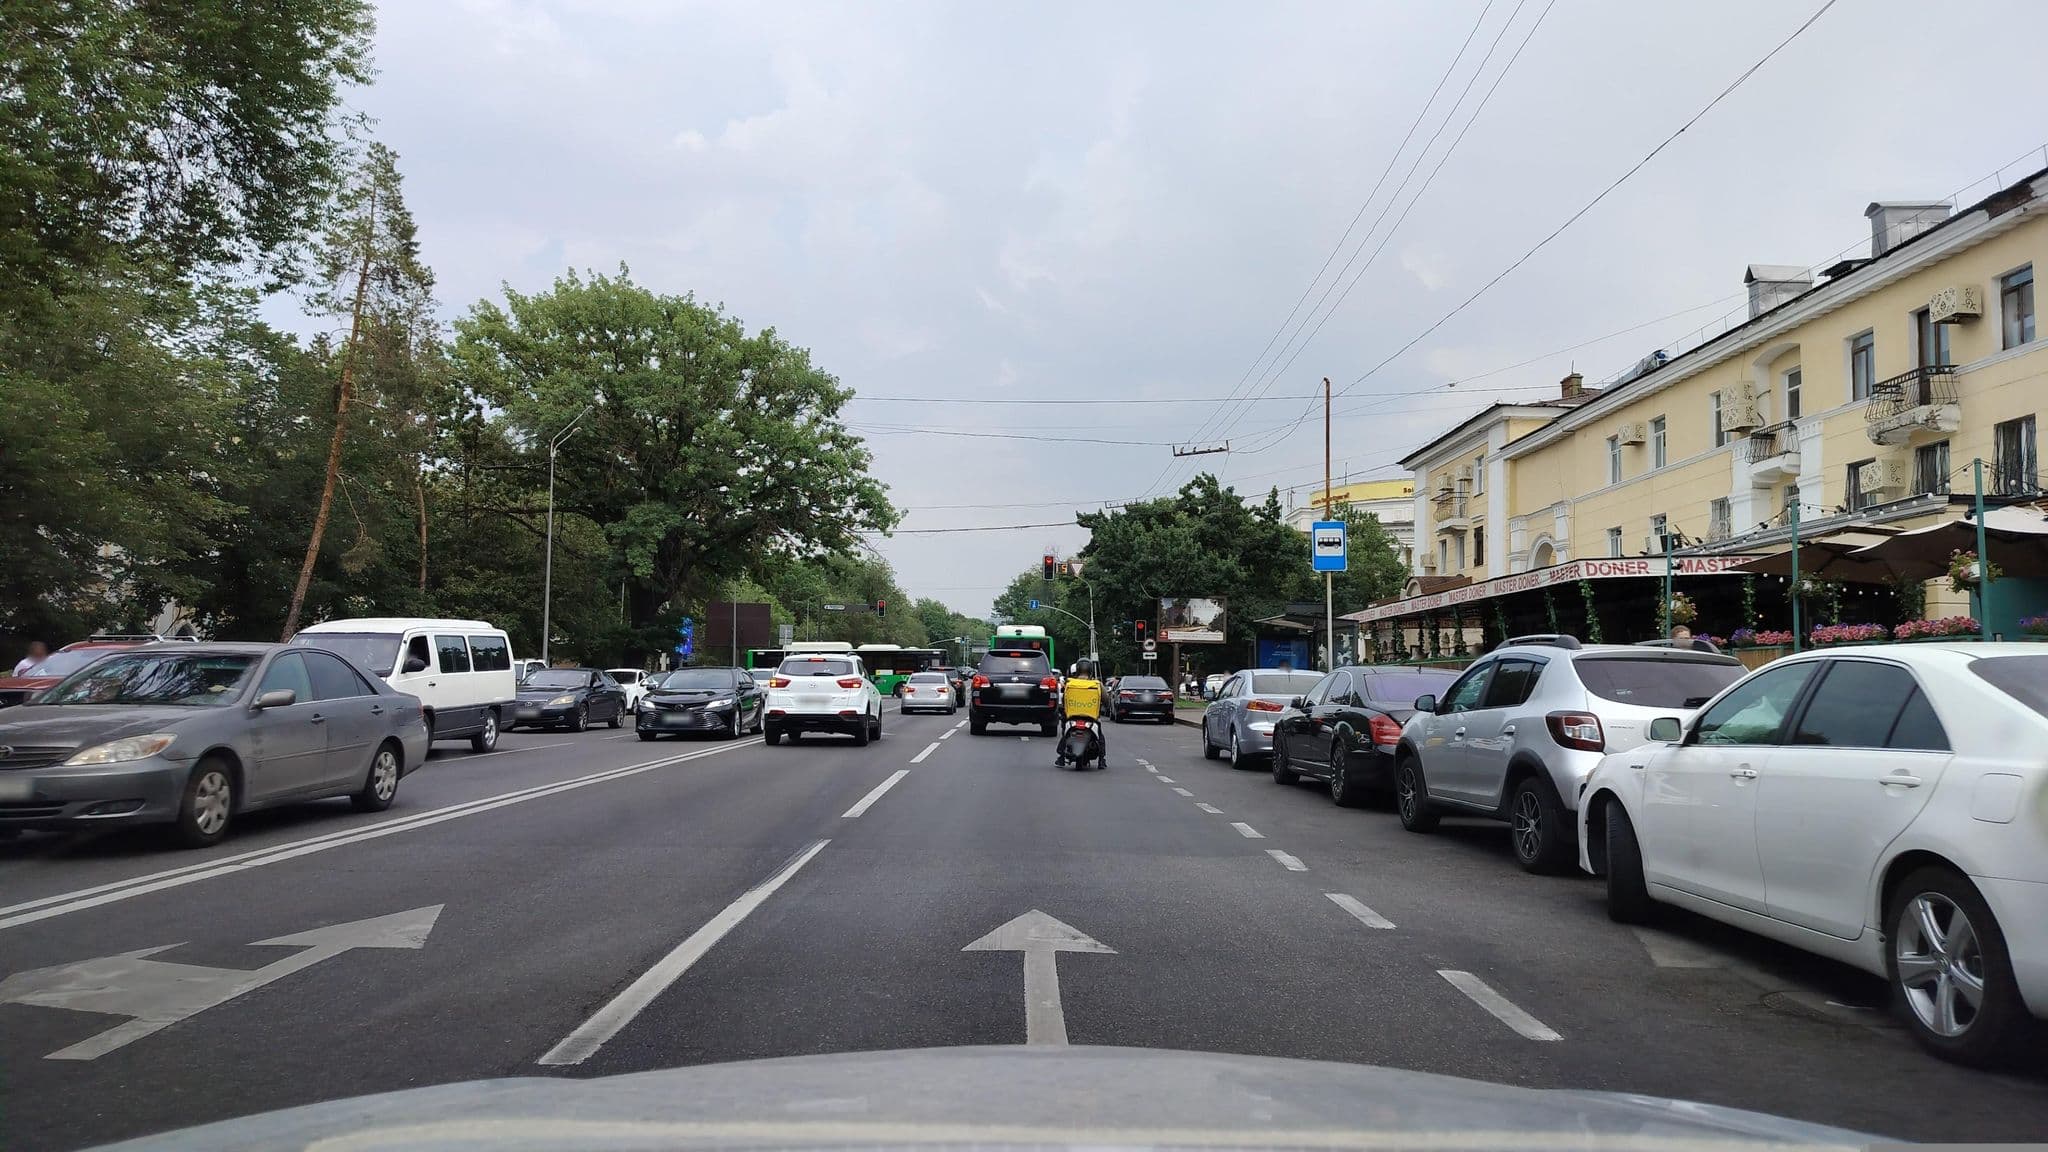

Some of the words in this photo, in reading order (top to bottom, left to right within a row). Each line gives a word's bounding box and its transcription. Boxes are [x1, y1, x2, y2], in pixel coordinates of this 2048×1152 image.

[1549, 564, 1581, 582] MASTER
[1585, 561, 1649, 576] DONER
[1494, 578, 1518, 593] MASTER
[1518, 574, 1540, 589] DONER
[1448, 588, 1468, 603] MASTER
[1468, 584, 1487, 600] DONER
